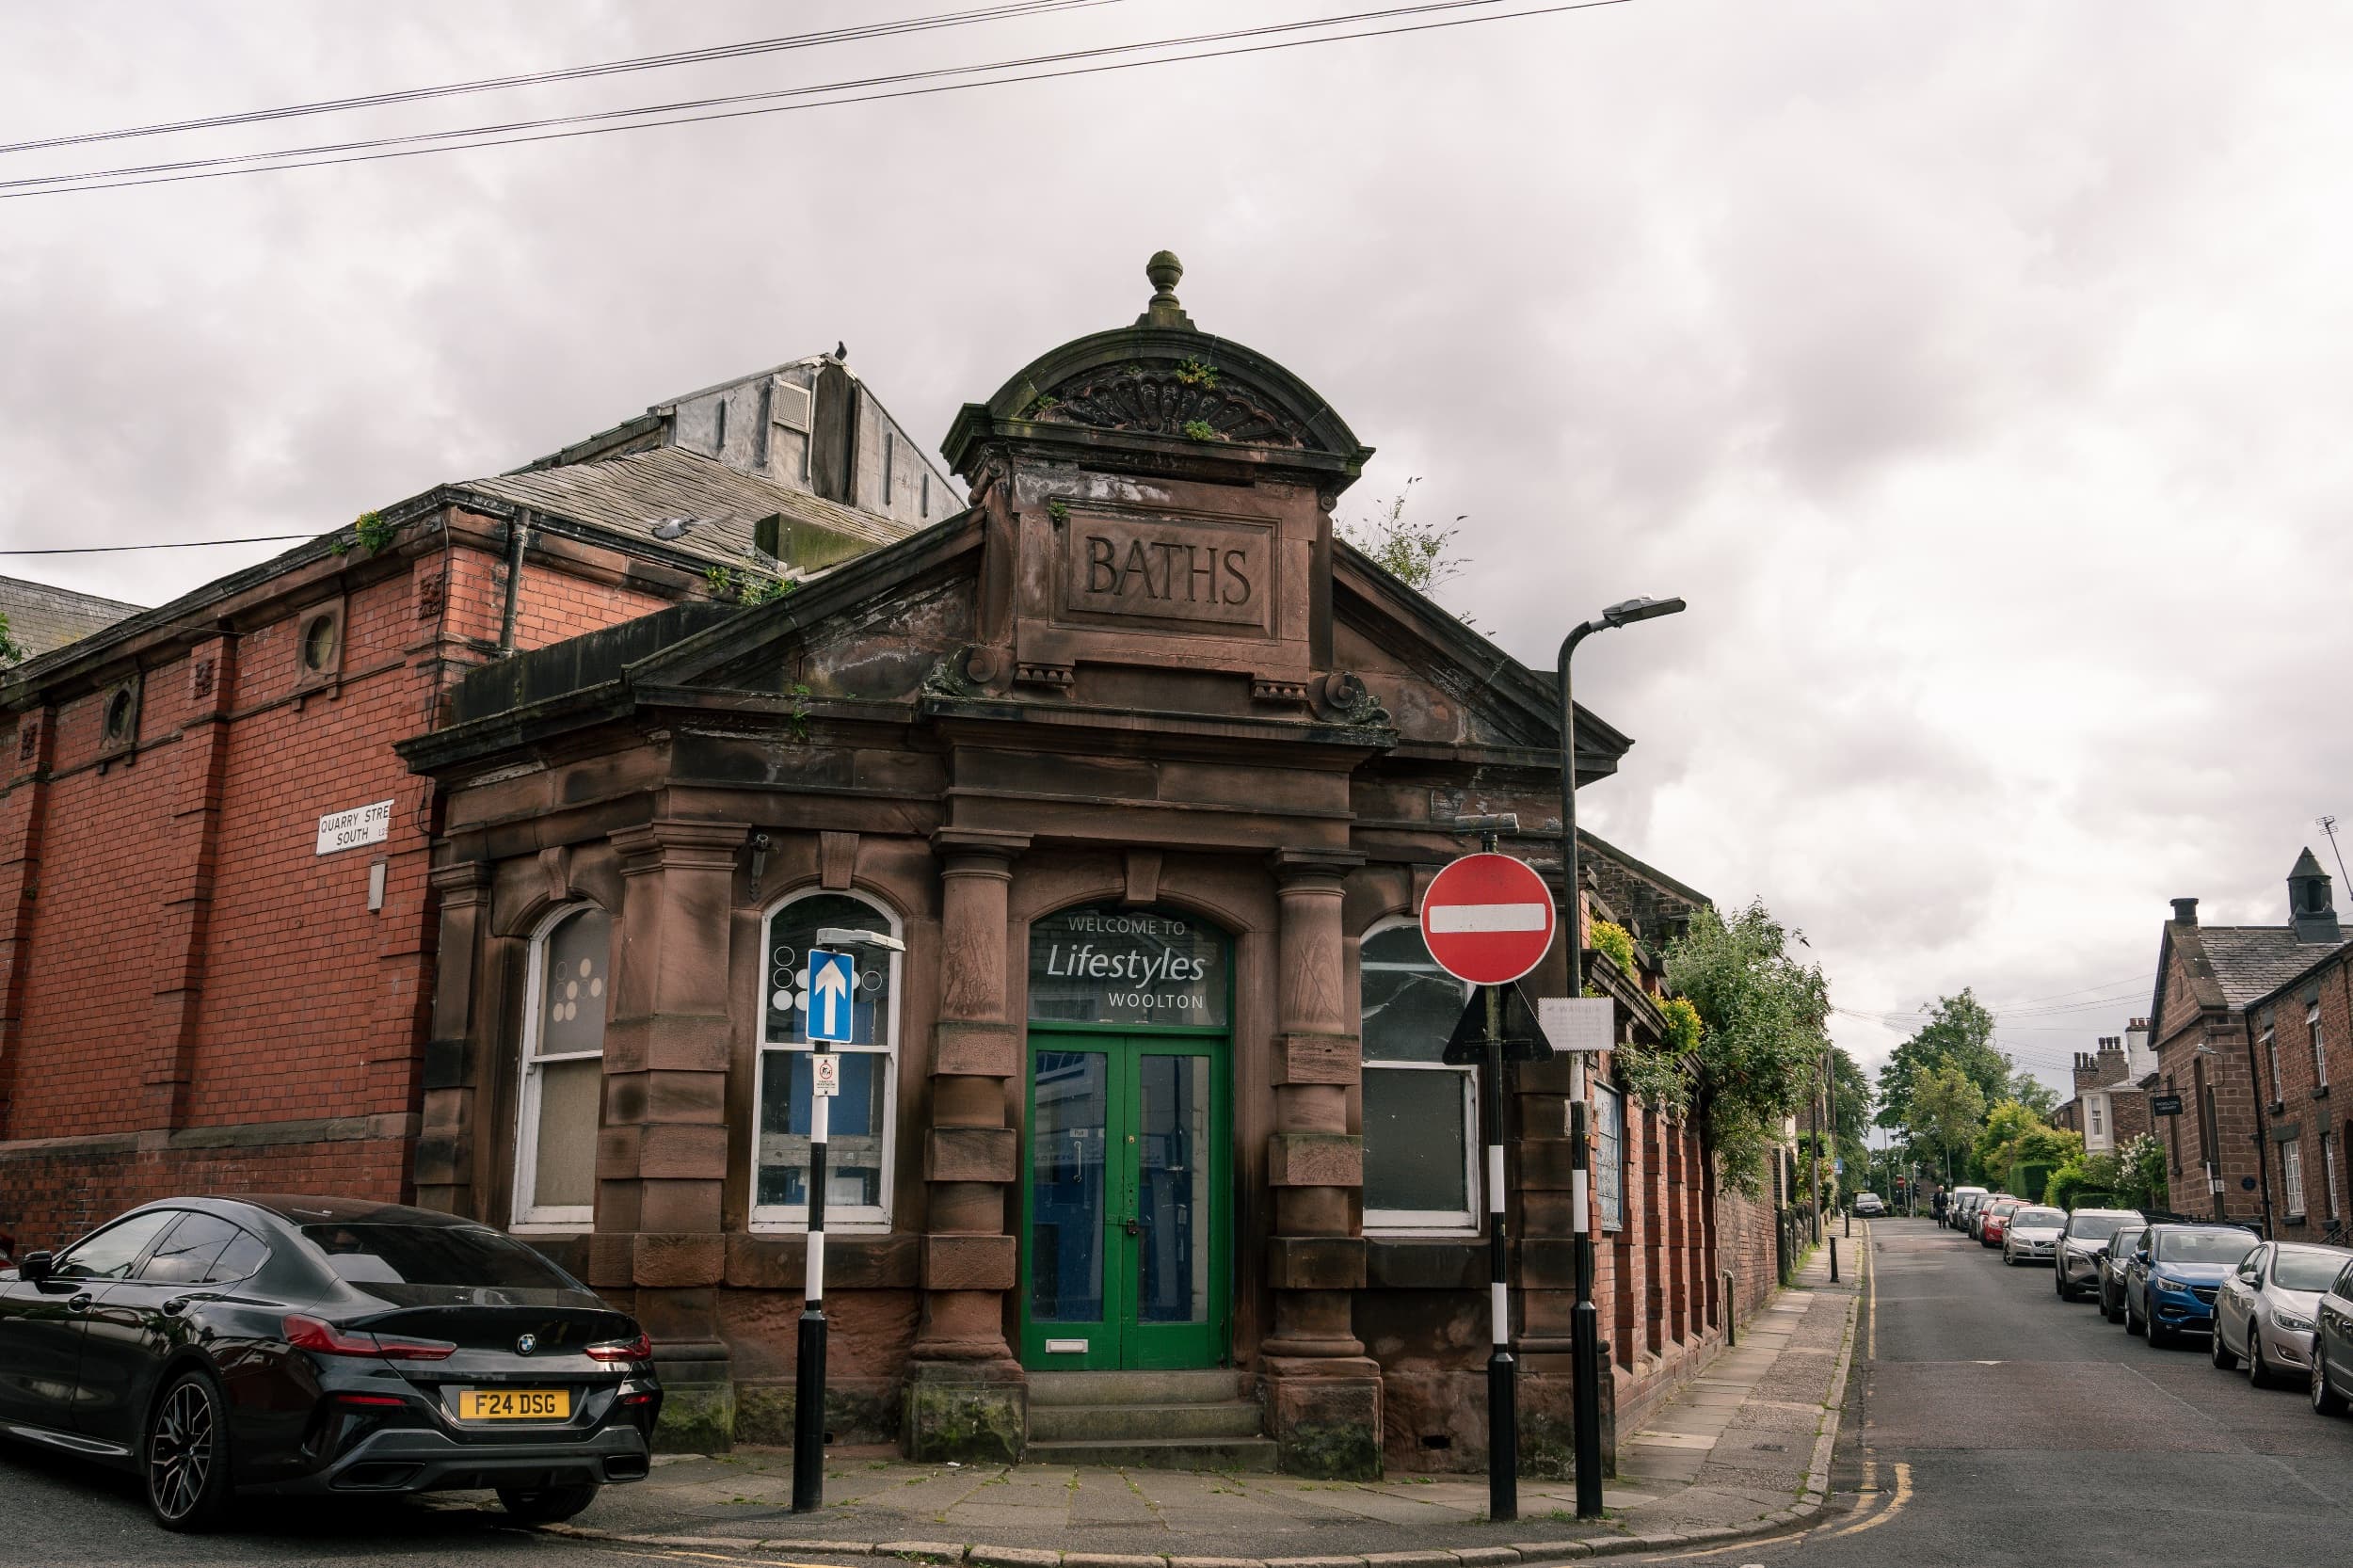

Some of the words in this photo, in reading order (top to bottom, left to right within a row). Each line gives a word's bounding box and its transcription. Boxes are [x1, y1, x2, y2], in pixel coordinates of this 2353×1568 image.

[1085, 536, 1252, 605] BATHS
[321, 812, 359, 833] QUARRY
[337, 826, 369, 845] SOUTH
[1068, 917, 1157, 934] WELCOME
[1163, 920, 1185, 936] TO
[1047, 944, 1206, 989] Lifestyles
[1108, 992, 1204, 1009] WOOLTON
[474, 1394, 514, 1415] F24
[520, 1394, 555, 1415] DSG
